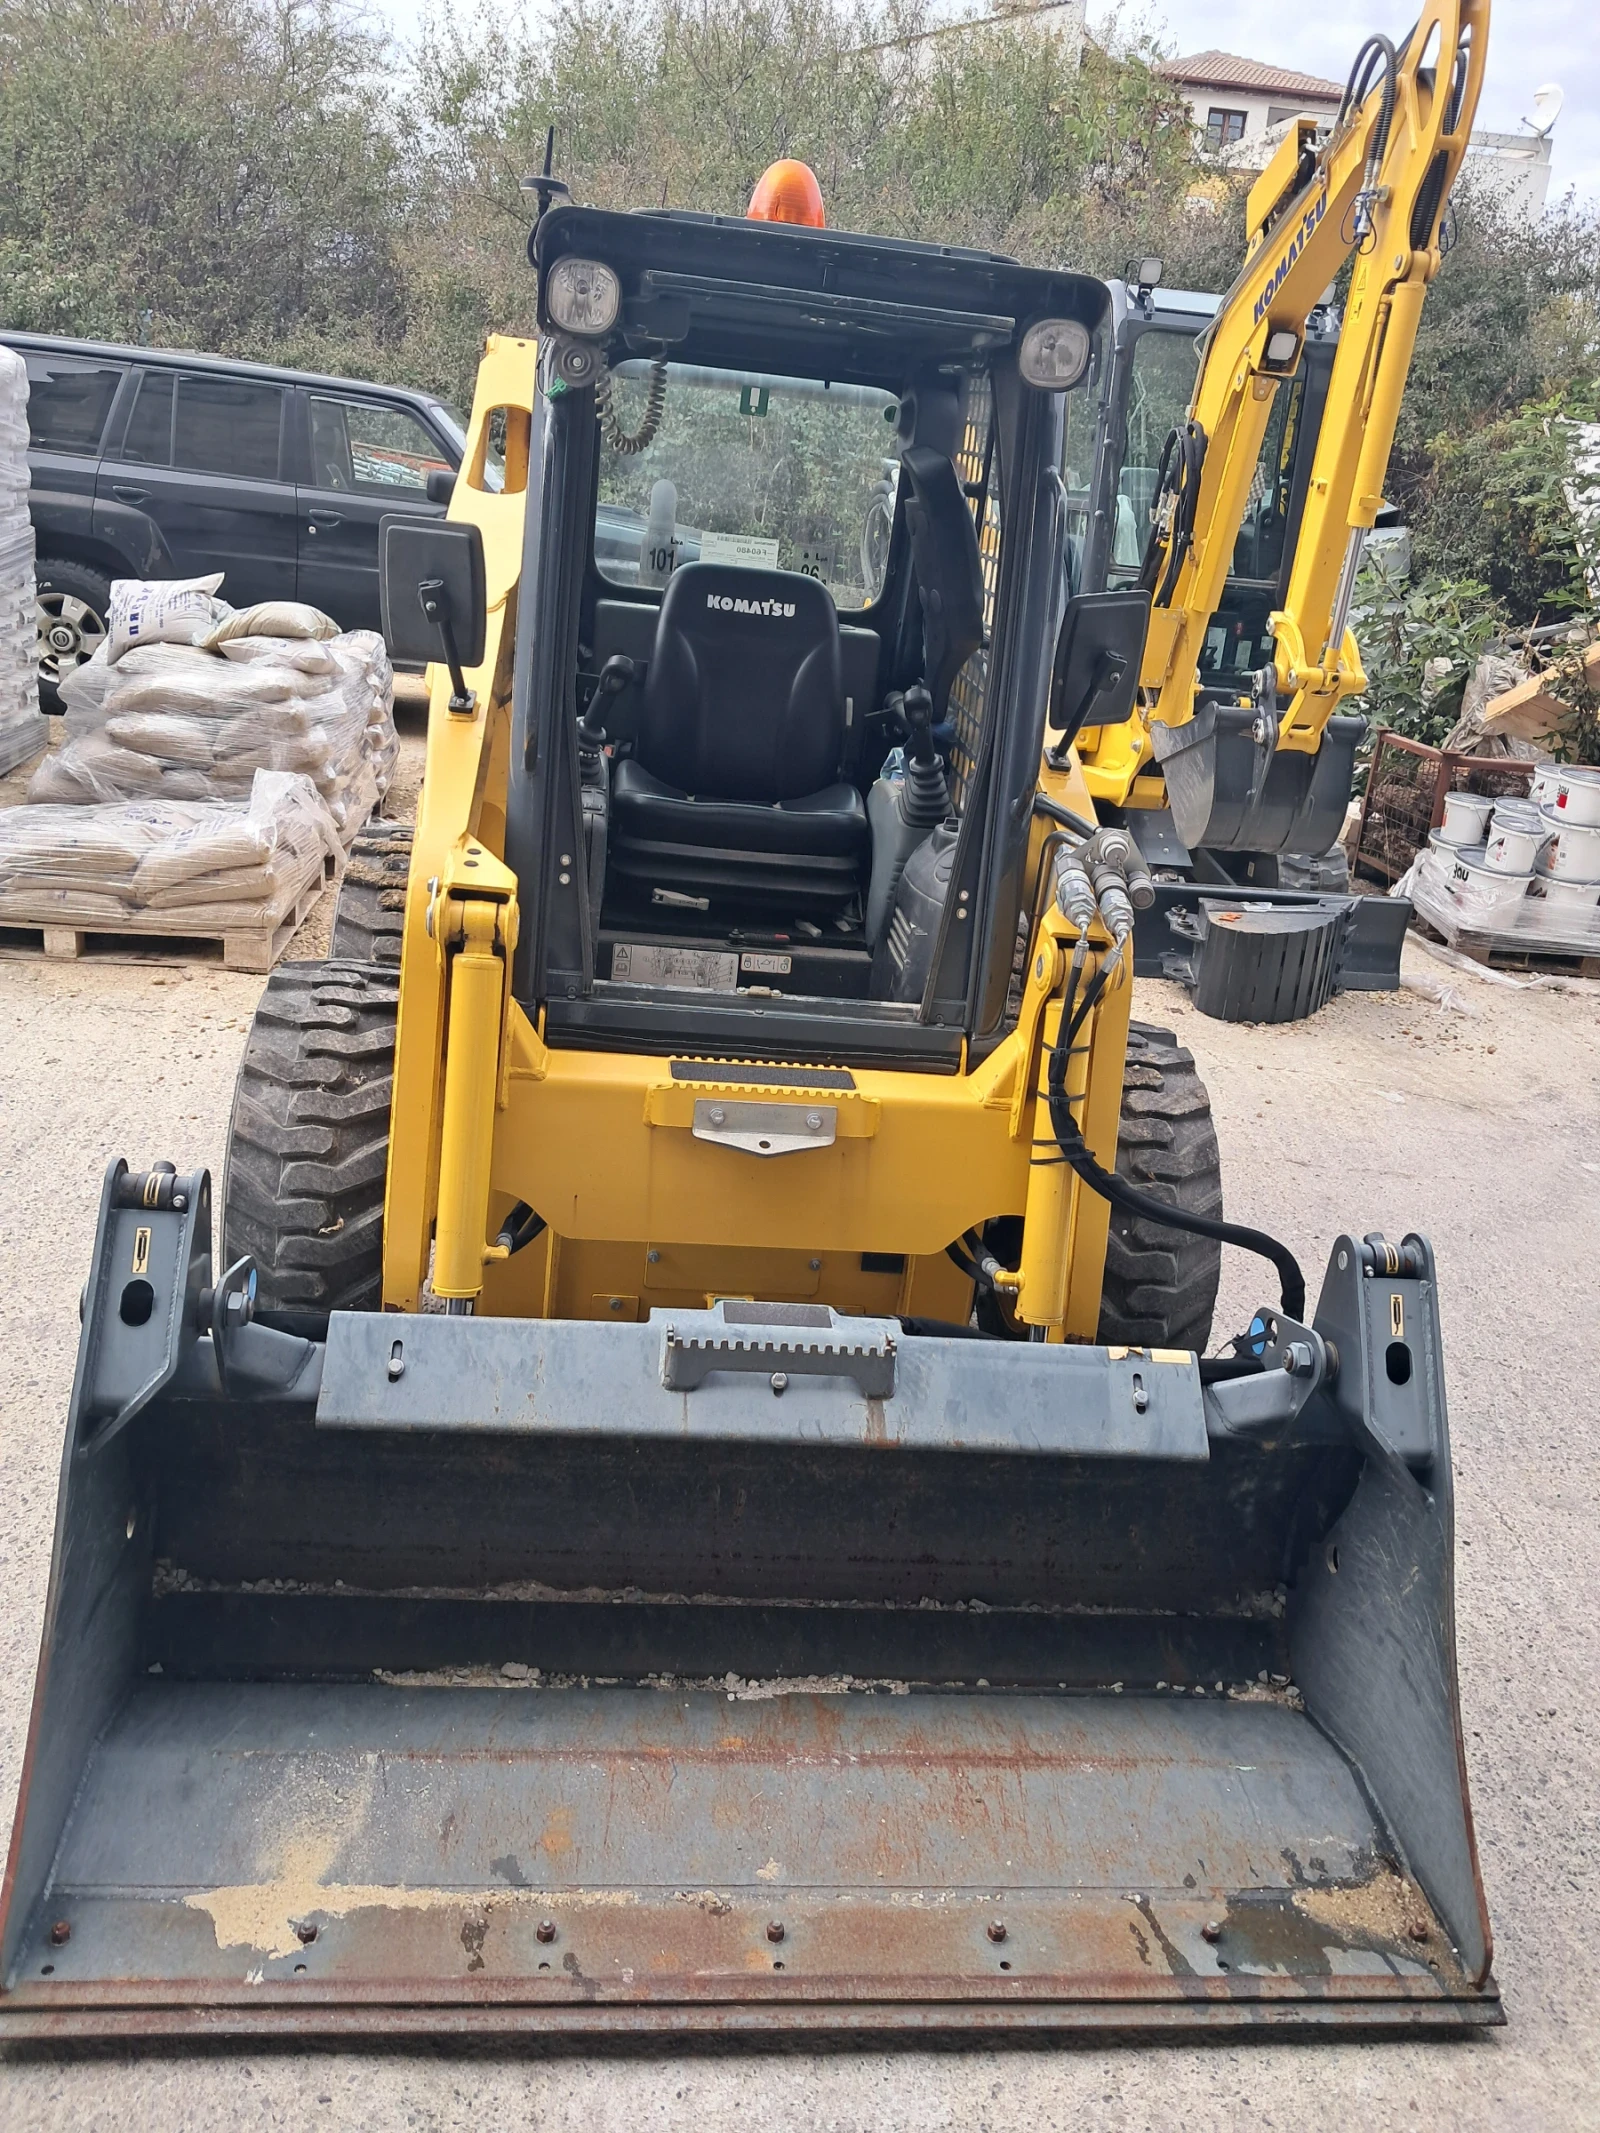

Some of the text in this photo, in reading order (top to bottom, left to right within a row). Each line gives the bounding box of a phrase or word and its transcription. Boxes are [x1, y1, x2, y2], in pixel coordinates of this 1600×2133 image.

[1253, 190, 1327, 326] KOMATSU
[650, 547, 675, 572] 101
[129, 587, 154, 636] ПЯСЪК
[707, 594, 796, 618] KOMATSU
